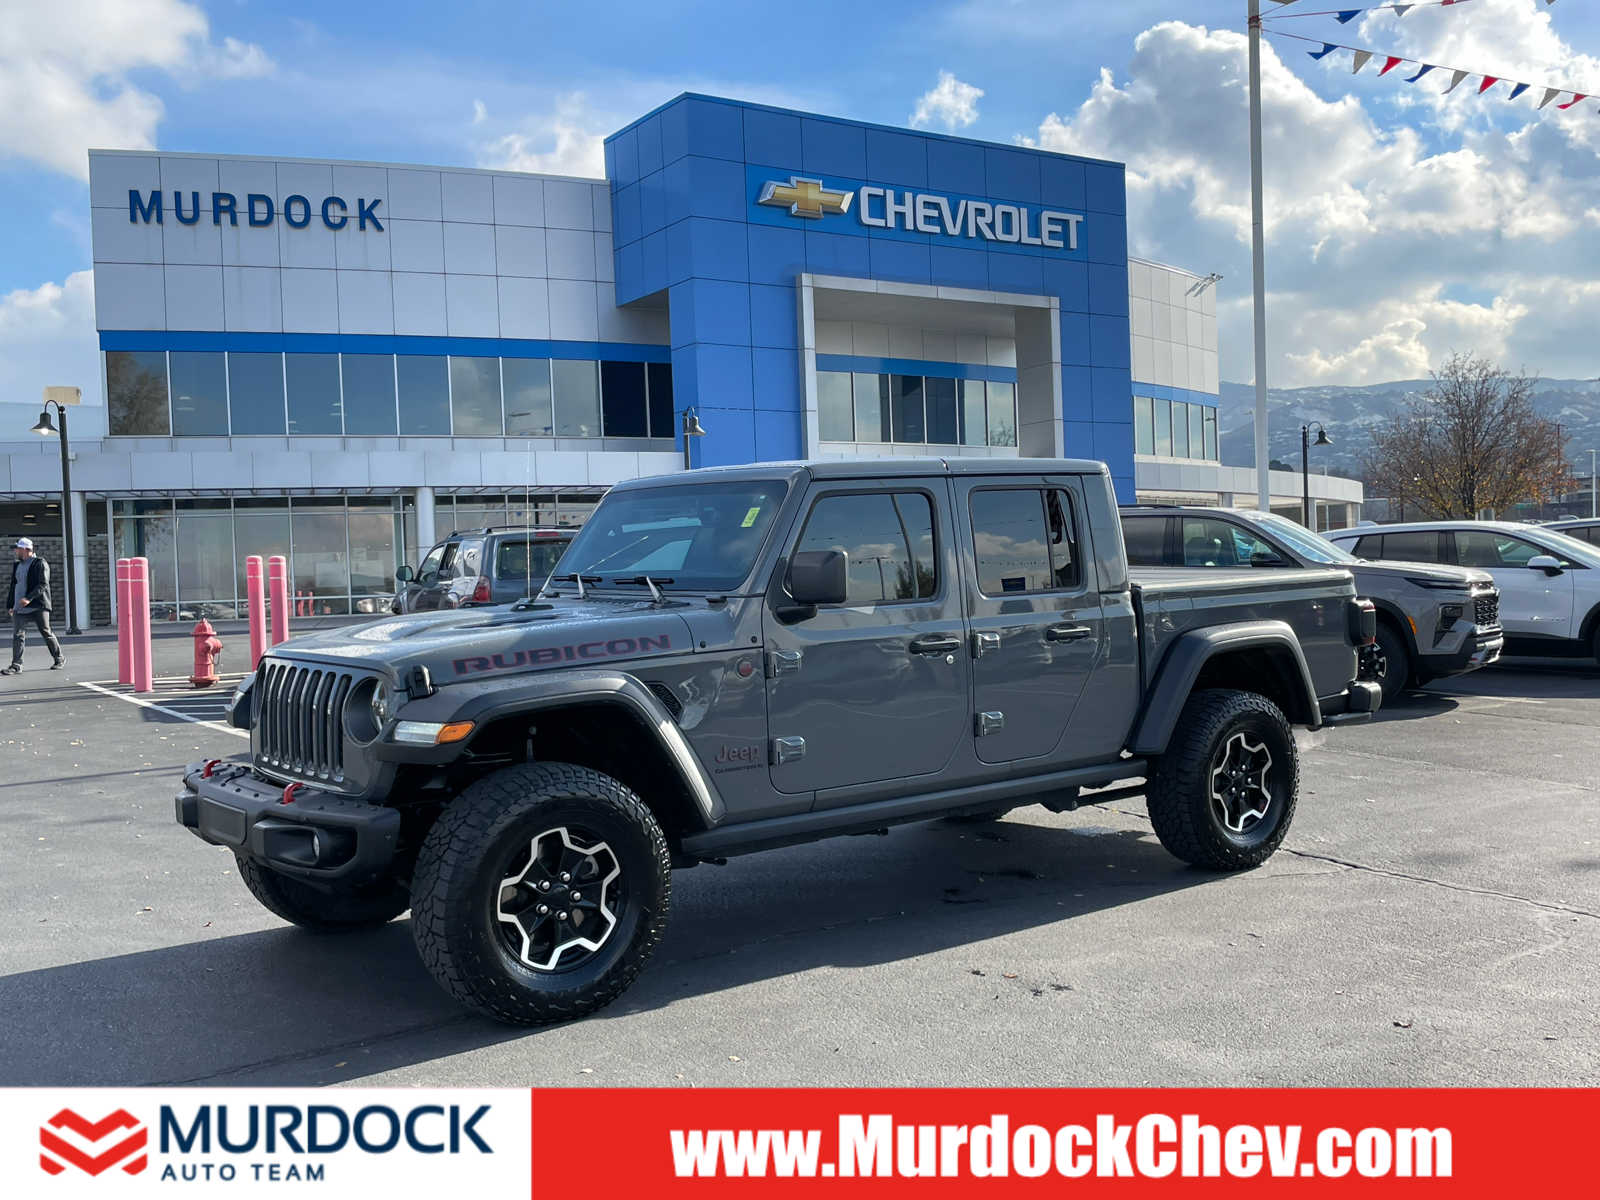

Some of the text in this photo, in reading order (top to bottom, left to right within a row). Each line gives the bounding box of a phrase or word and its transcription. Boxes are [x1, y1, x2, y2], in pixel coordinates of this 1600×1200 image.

[128, 189, 385, 232] MURDOCK
[859, 186, 1084, 249] CHEVROLET
[452, 634, 672, 676] RUBICON
[714, 744, 761, 764] Jeep
